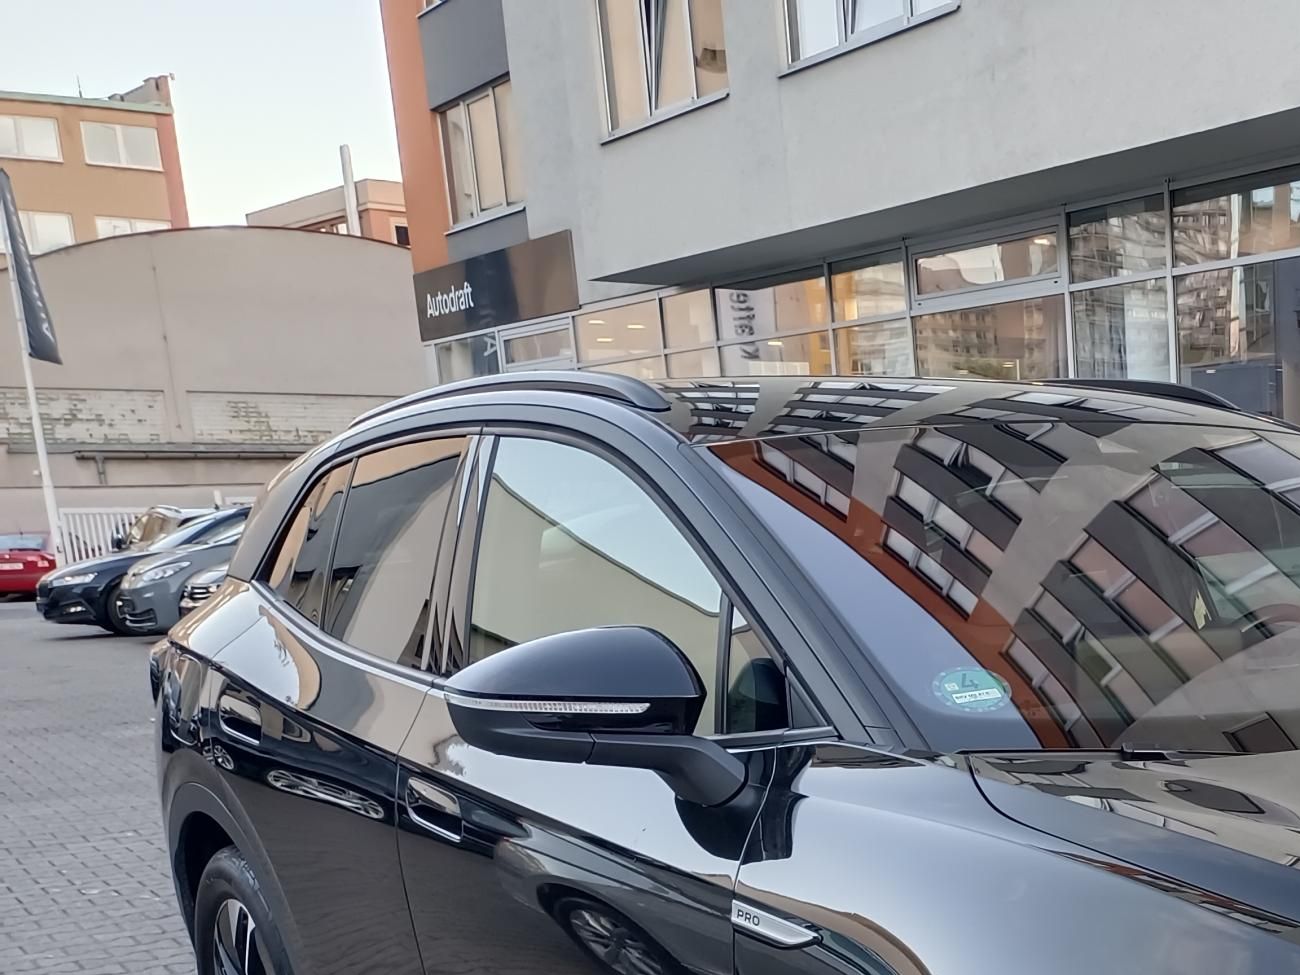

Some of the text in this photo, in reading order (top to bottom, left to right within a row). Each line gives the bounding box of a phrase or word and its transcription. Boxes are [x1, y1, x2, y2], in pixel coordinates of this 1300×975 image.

[427, 281, 474, 318] Autodraft
[961, 673, 979, 689] 4
[737, 909, 760, 927] PRO
